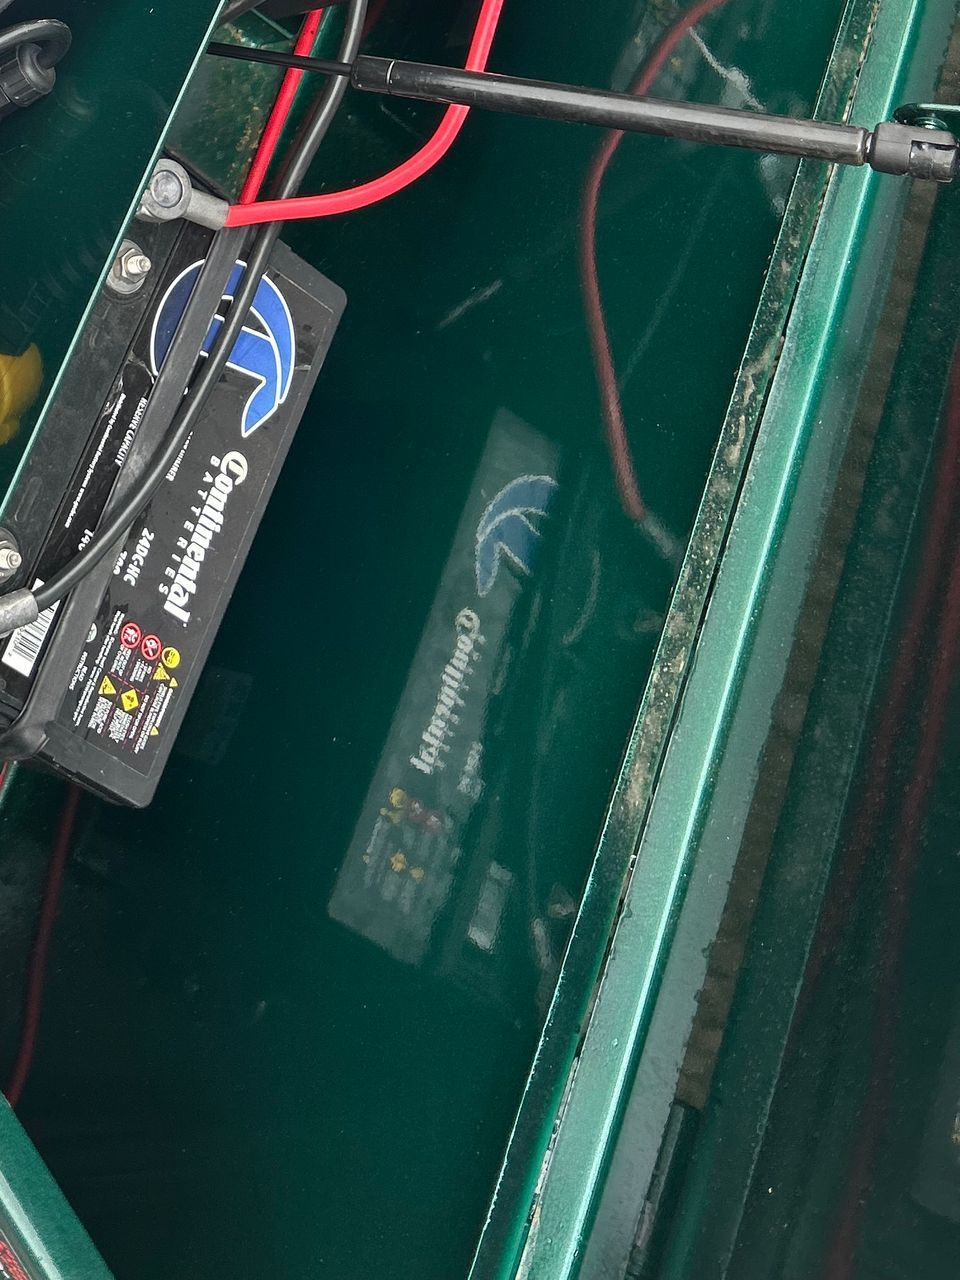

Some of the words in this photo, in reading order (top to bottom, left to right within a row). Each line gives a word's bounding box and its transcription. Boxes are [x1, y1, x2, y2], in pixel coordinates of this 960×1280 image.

[112, 428, 135, 467] CAPACITY
[158, 455, 221, 595] BATTERIES
[163, 451, 249, 623] Continental
[121, 526, 155, 586] 24DC-HC
[67, 650, 87, 690] INSTRUCTIONS
[77, 665, 88, 682] READ
